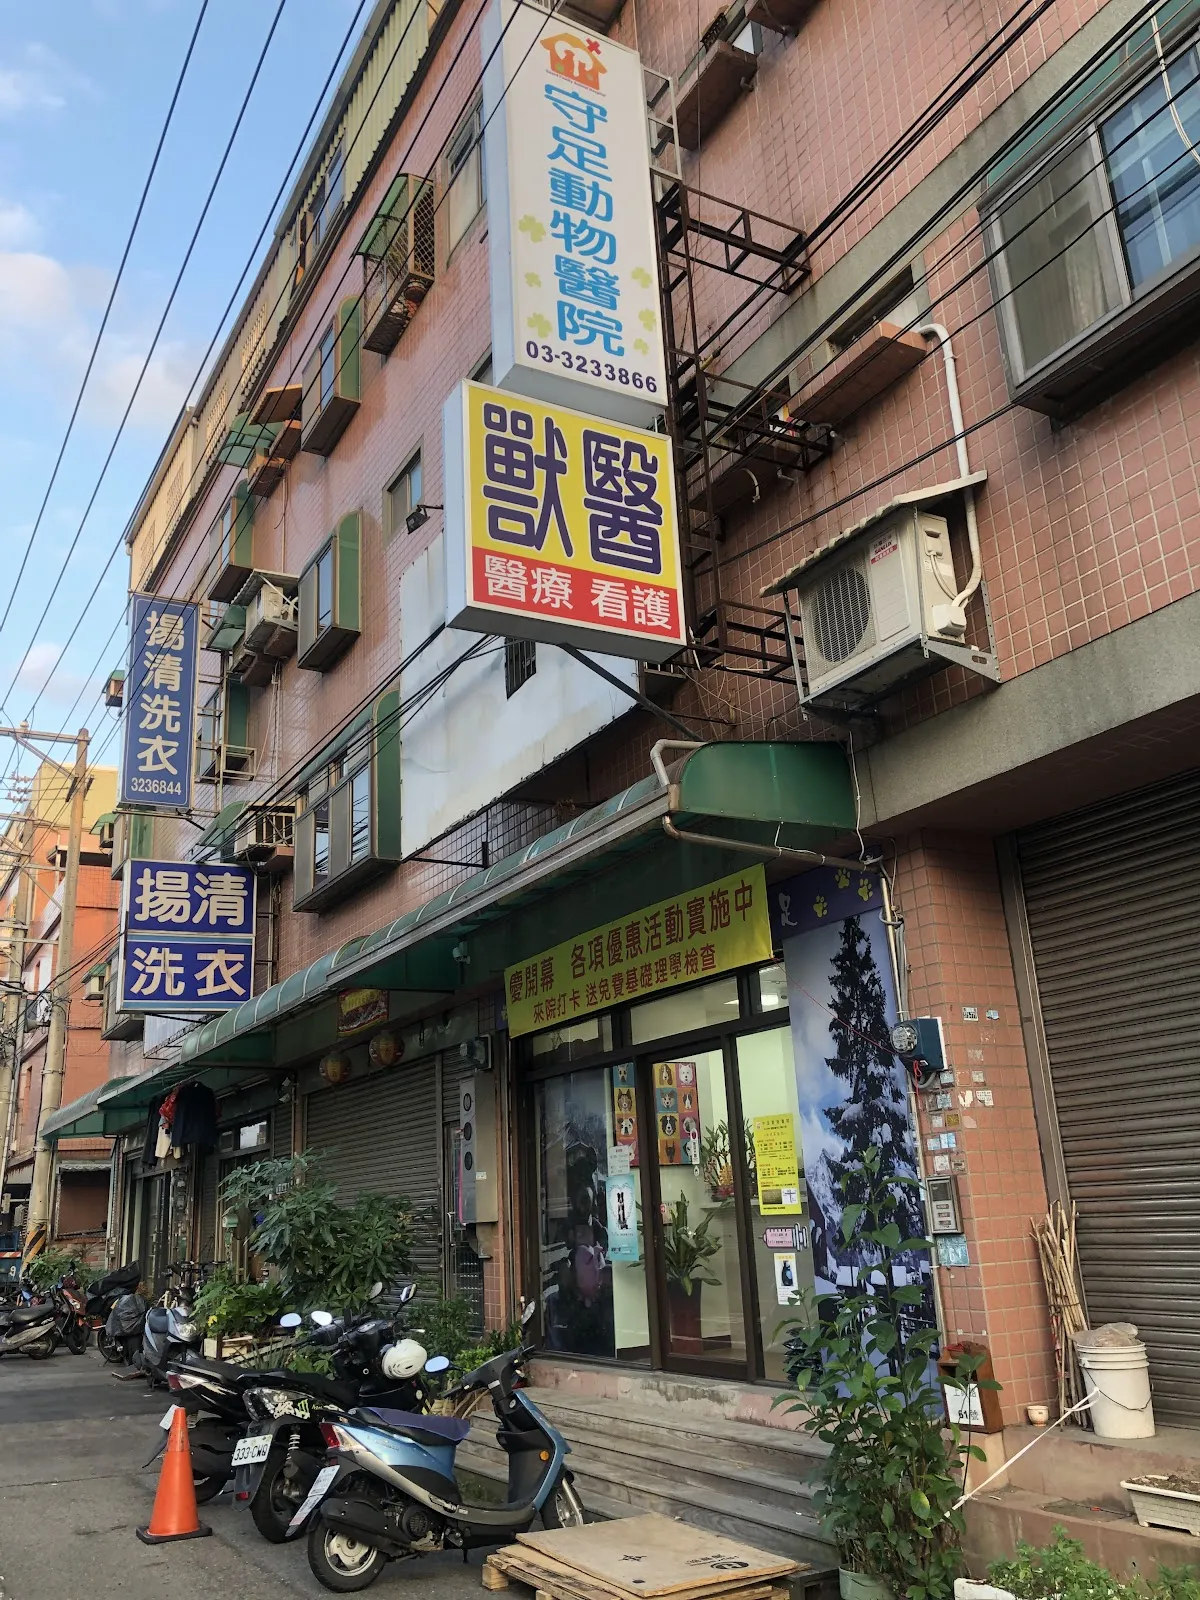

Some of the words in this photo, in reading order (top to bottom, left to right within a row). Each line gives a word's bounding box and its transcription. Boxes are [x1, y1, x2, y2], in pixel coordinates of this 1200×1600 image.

[544, 83, 625, 357] 守足動物醫院
[526, 340, 657, 393] 03-3233866
[483, 402, 663, 575] 獸醫
[484, 554, 573, 610] 醫療
[590, 578, 672, 630] 看護
[136, 610, 184, 775] 揚清洗衣
[131, 777, 182, 796] 3236844
[134, 867, 248, 926] 揚清
[130, 946, 246, 996] 洗衣
[509, 957, 554, 1004] 慶開幕
[570, 879, 753, 980] 各項優惠活動實施中
